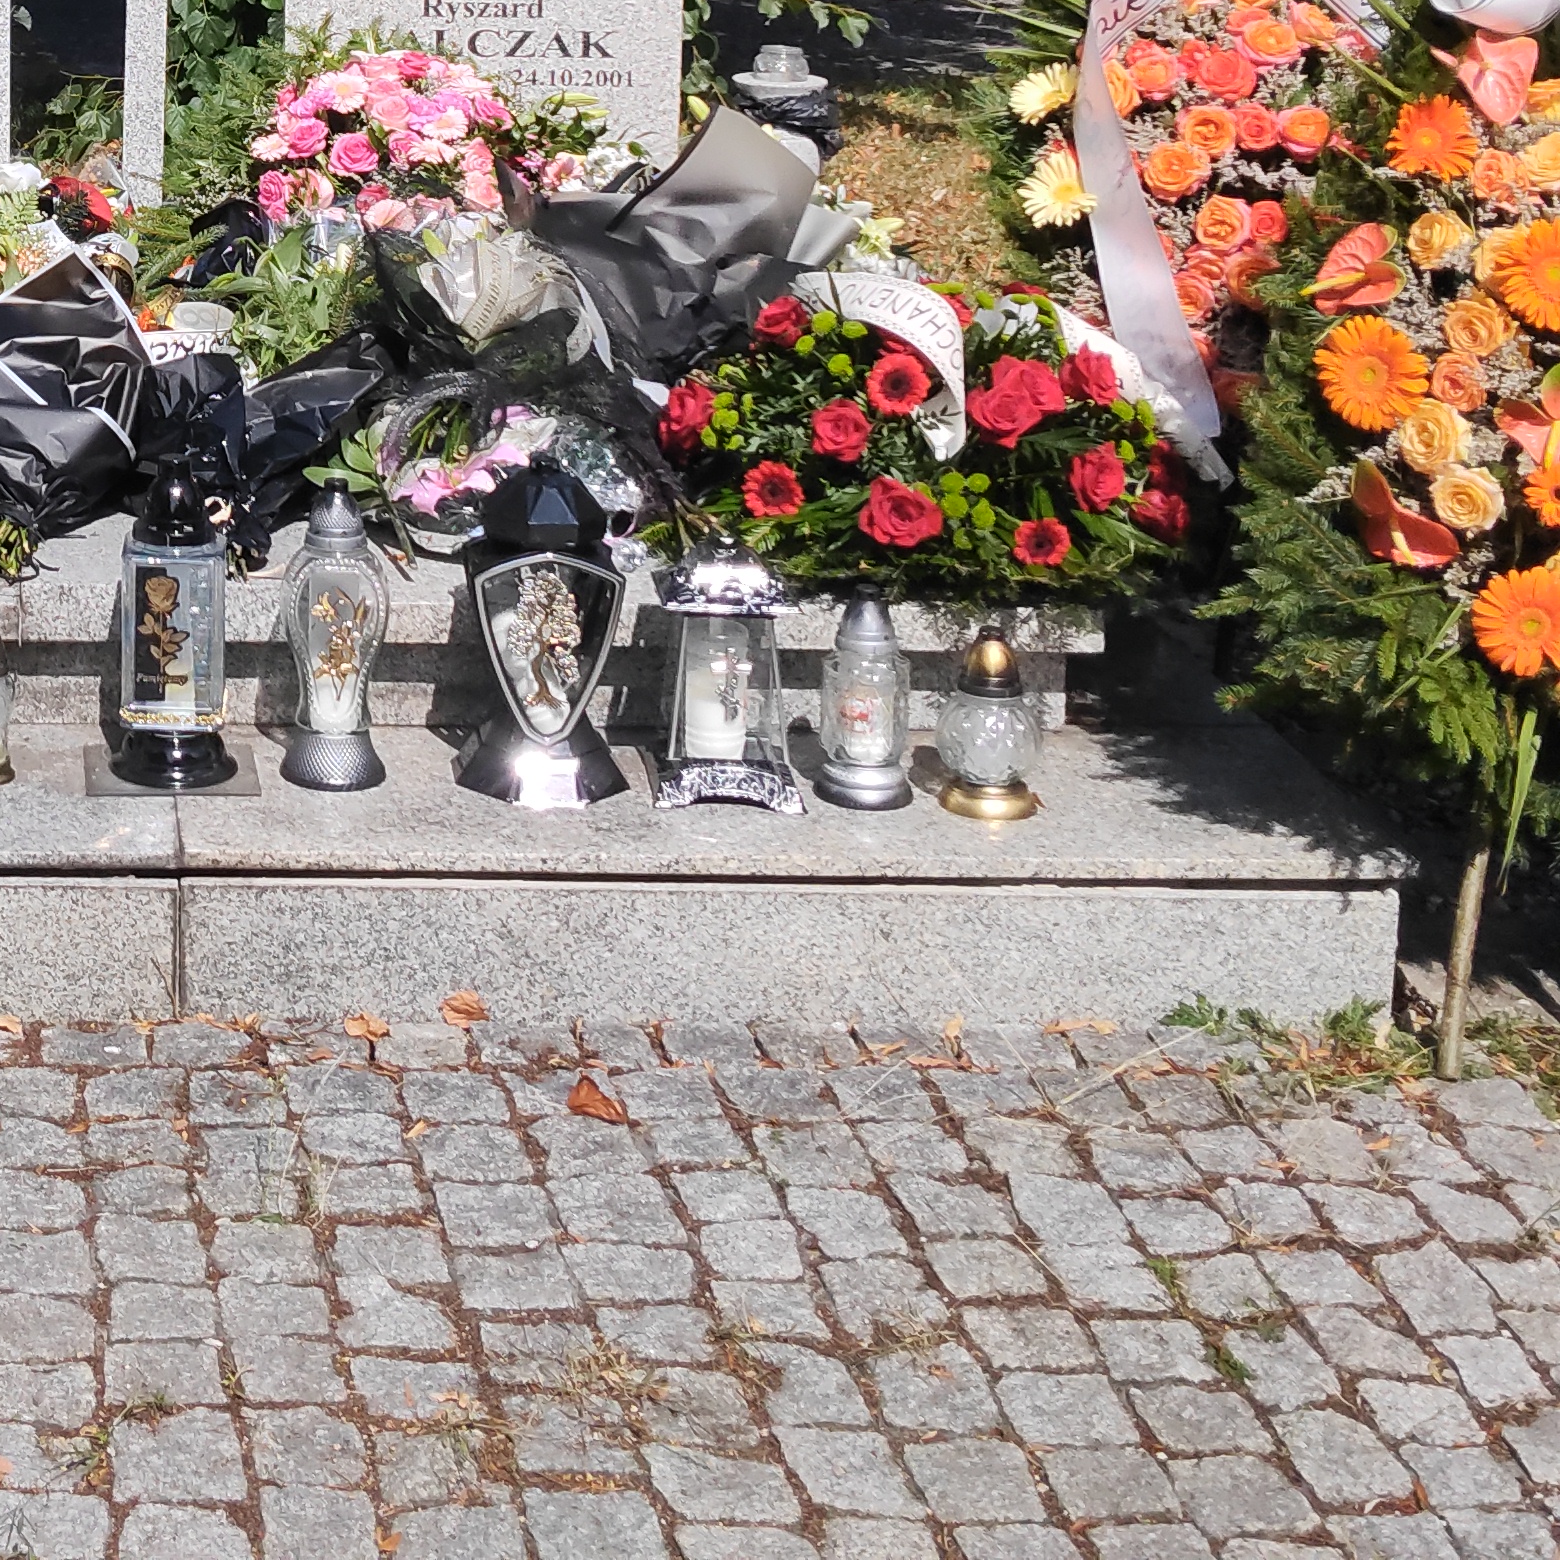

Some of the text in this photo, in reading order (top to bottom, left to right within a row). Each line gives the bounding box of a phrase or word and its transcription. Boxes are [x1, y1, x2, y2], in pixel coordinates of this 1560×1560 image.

[348, 27, 617, 59] LCZAK
[513, 68, 635, 89] 24.10.2001
[840, 283, 963, 372] OCHANEMU
